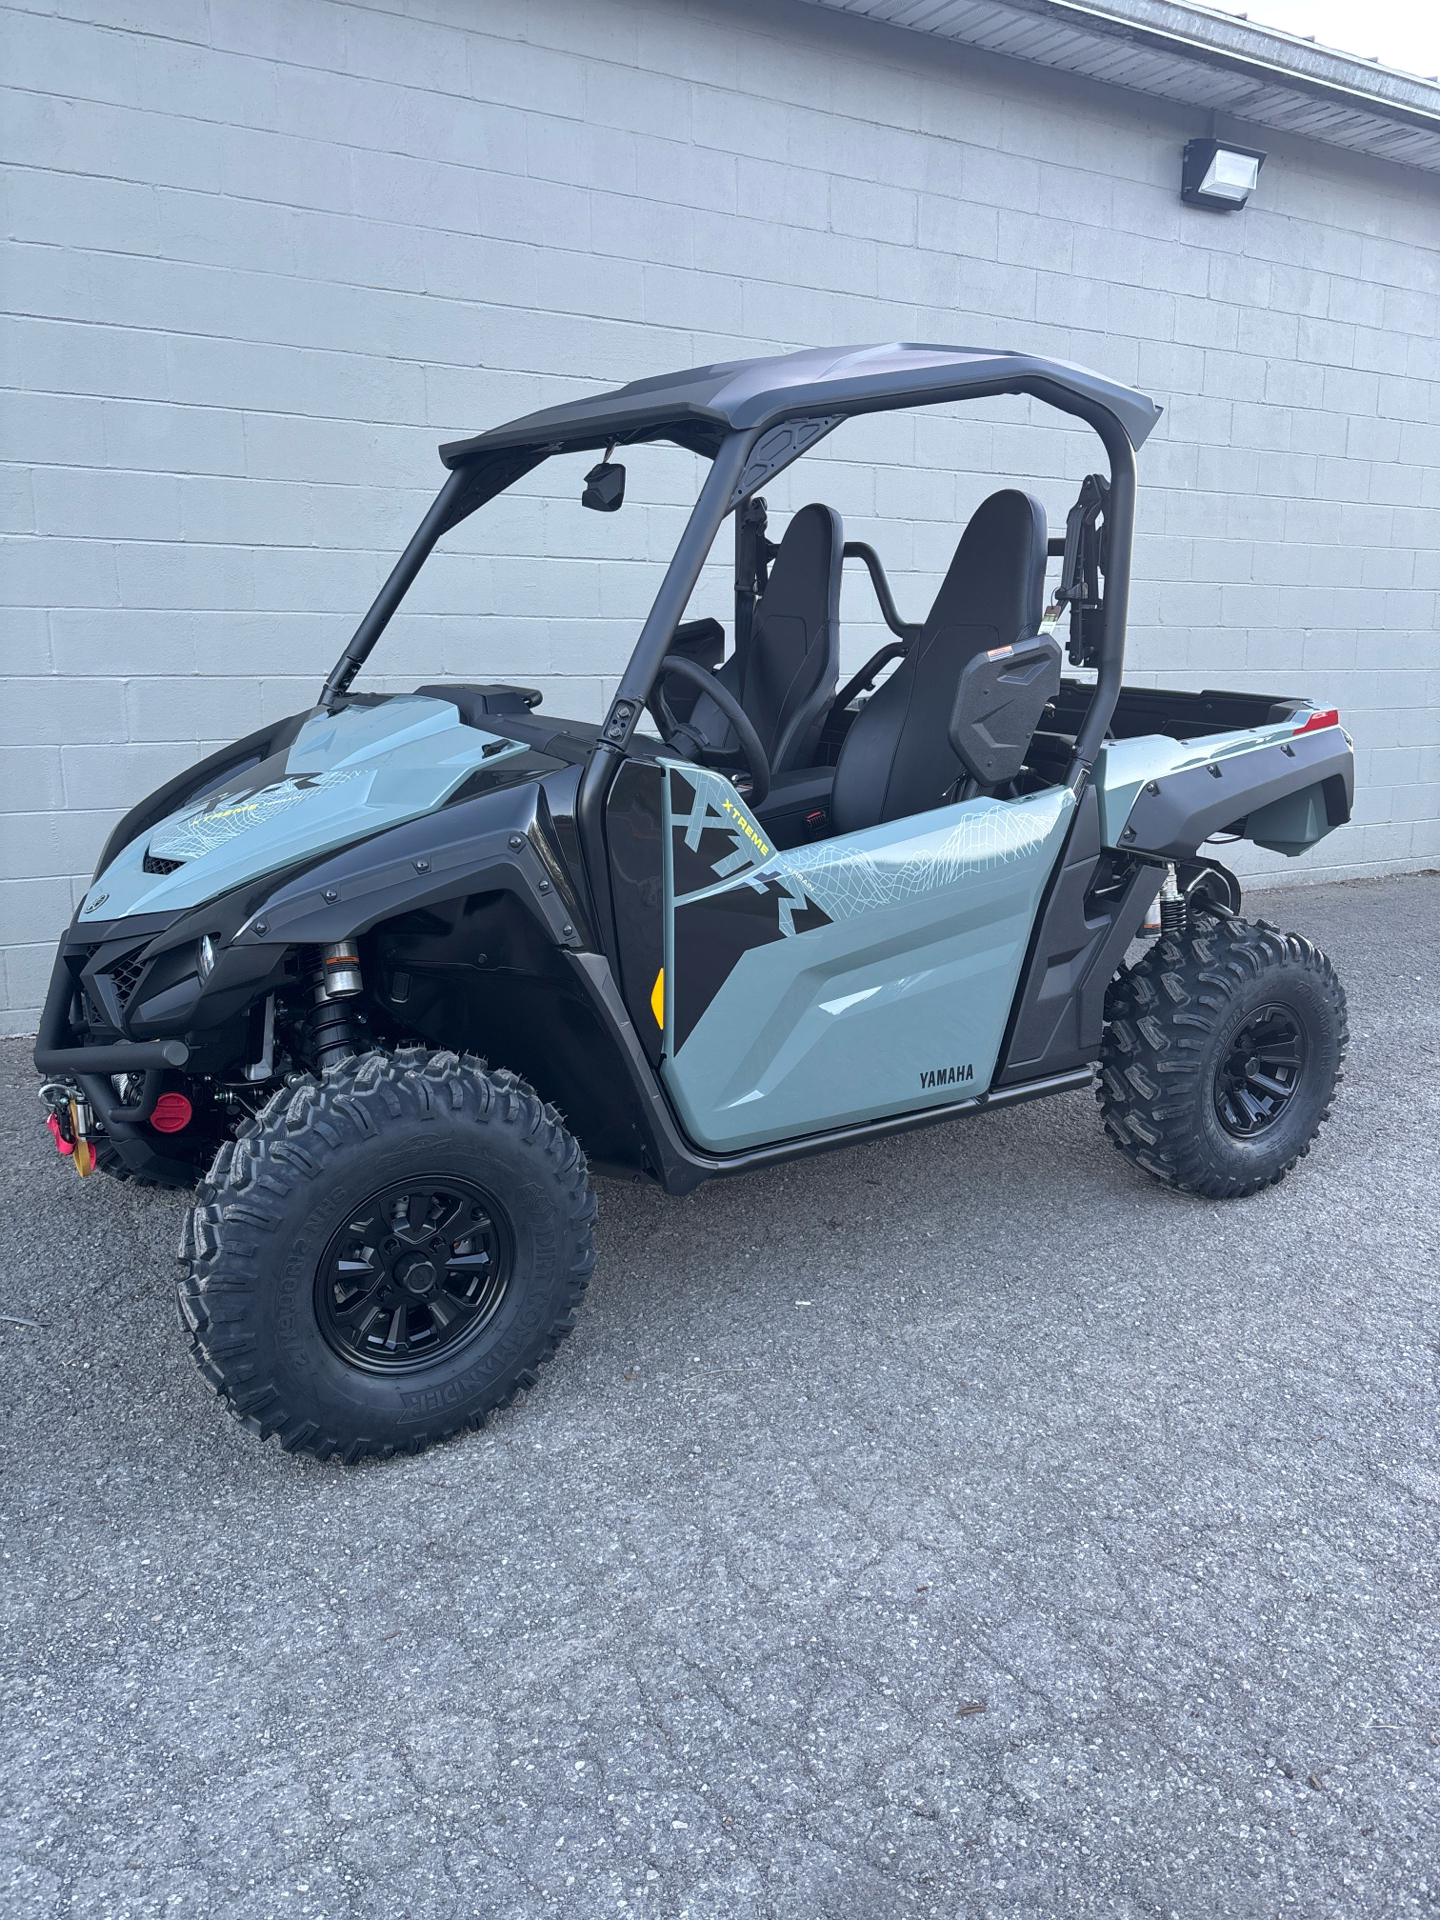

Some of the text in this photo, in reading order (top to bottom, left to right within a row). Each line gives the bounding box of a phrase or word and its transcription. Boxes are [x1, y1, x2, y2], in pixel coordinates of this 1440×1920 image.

[722, 798, 815, 892] XTREME TERRAIN
[919, 1063, 974, 1090] YAMAHA
[303, 1186, 348, 1234] NHS
[410, 1229, 557, 1418] DIRT COMMANDER
